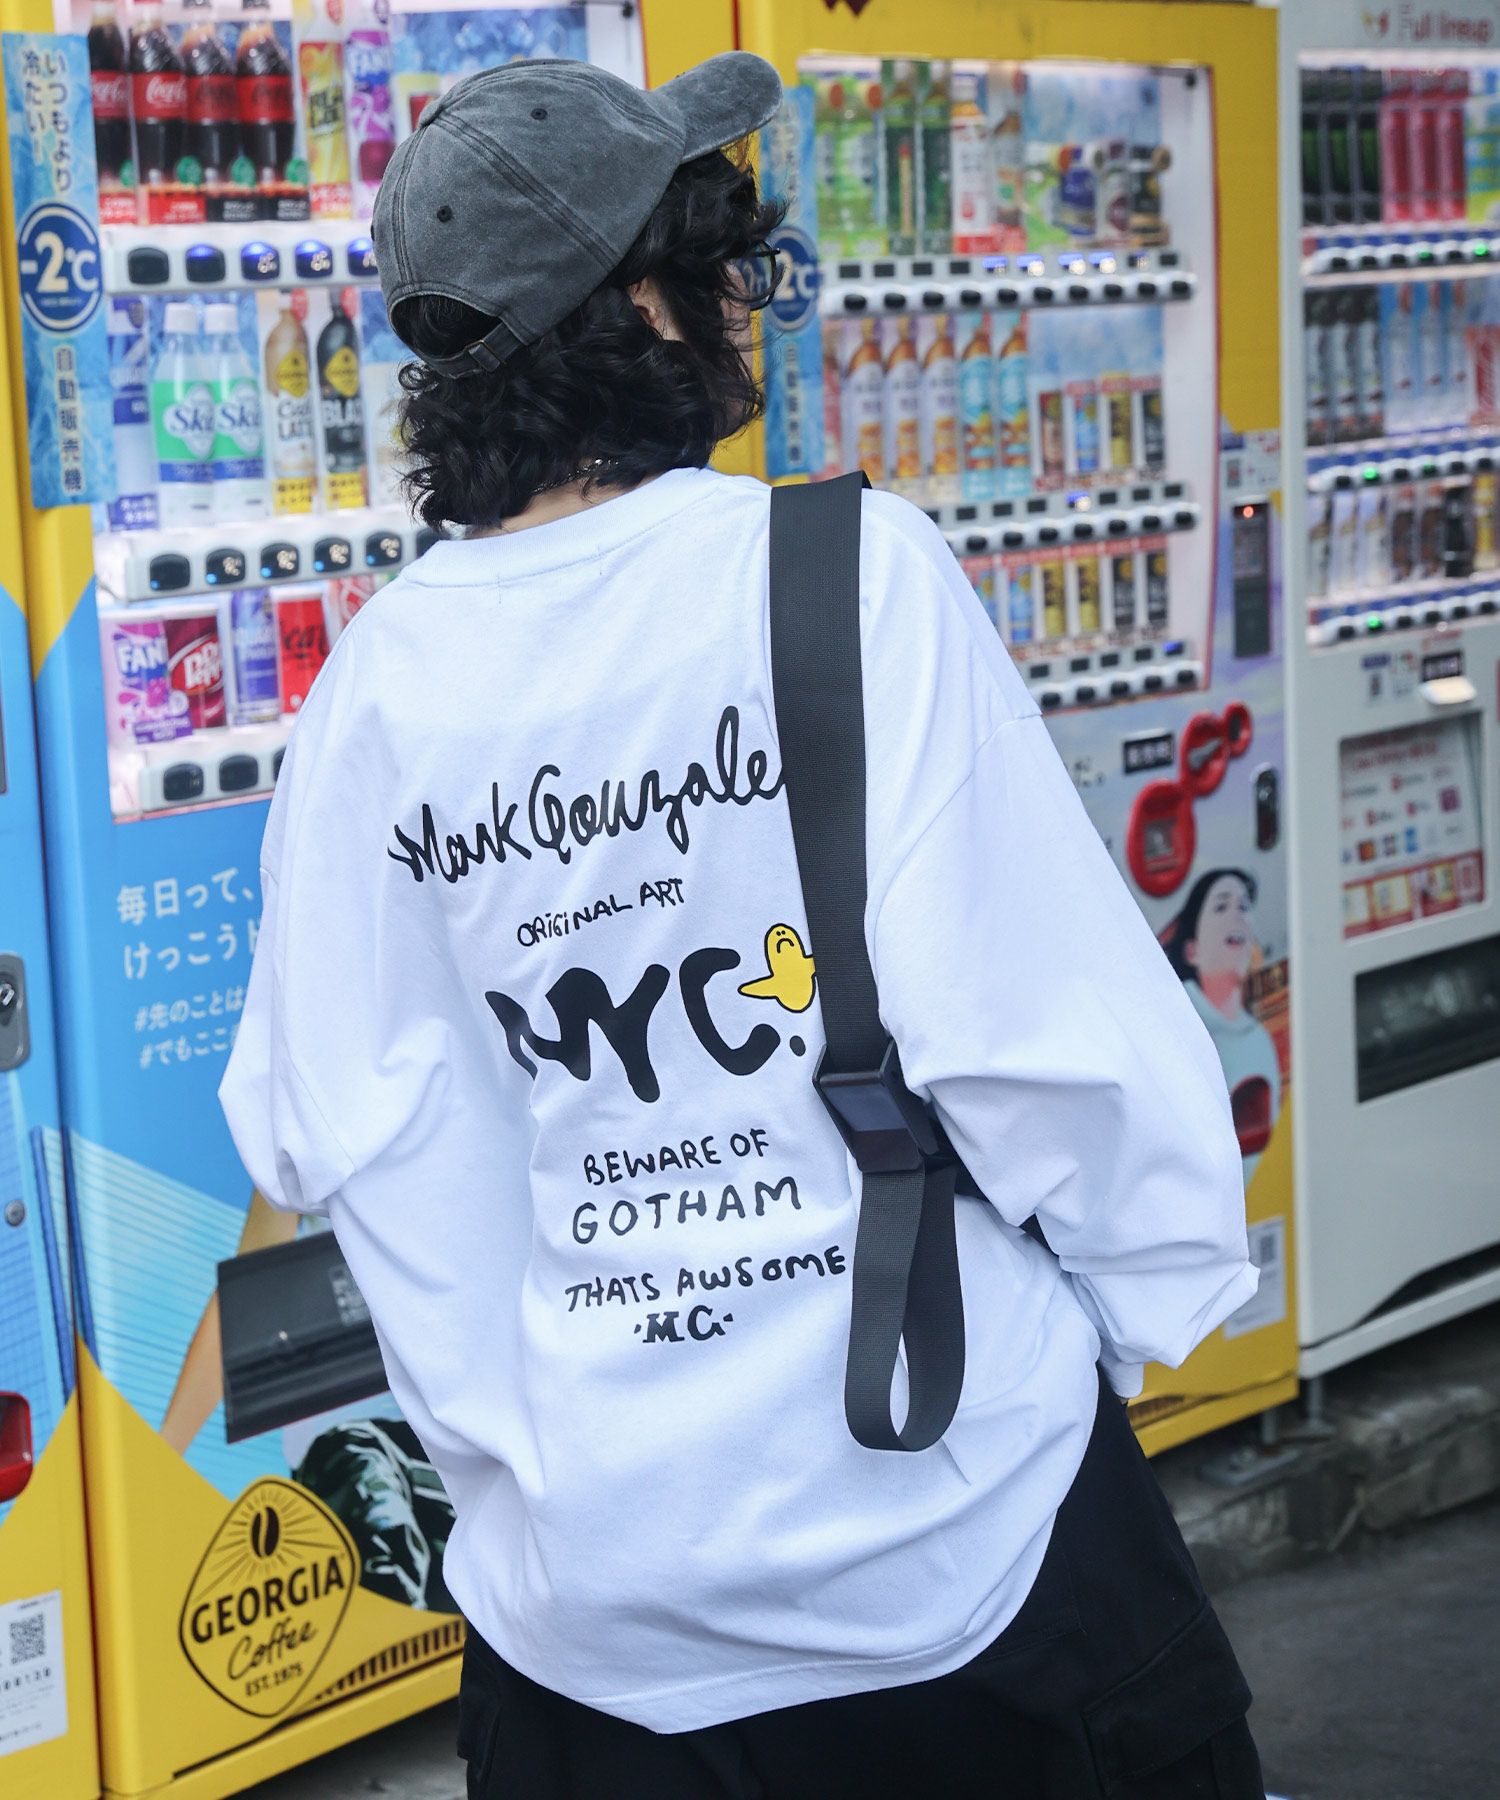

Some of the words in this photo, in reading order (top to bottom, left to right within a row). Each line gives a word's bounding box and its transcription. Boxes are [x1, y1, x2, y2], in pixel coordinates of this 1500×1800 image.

[45, 52, 73, 193] いつもより
[388, 782, 532, 883] Mark
[116, 867, 254, 926] 毎日って、
[640, 878, 685, 908] ART
[583, 1135, 722, 1185] BEWARE
[730, 1128, 769, 1157] OF
[572, 1176, 802, 1244] GOTHAM
[565, 1273, 660, 1312] THATS
[191, 1555, 345, 1644] GEORGIA
[227, 1616, 318, 1680] Coffee
